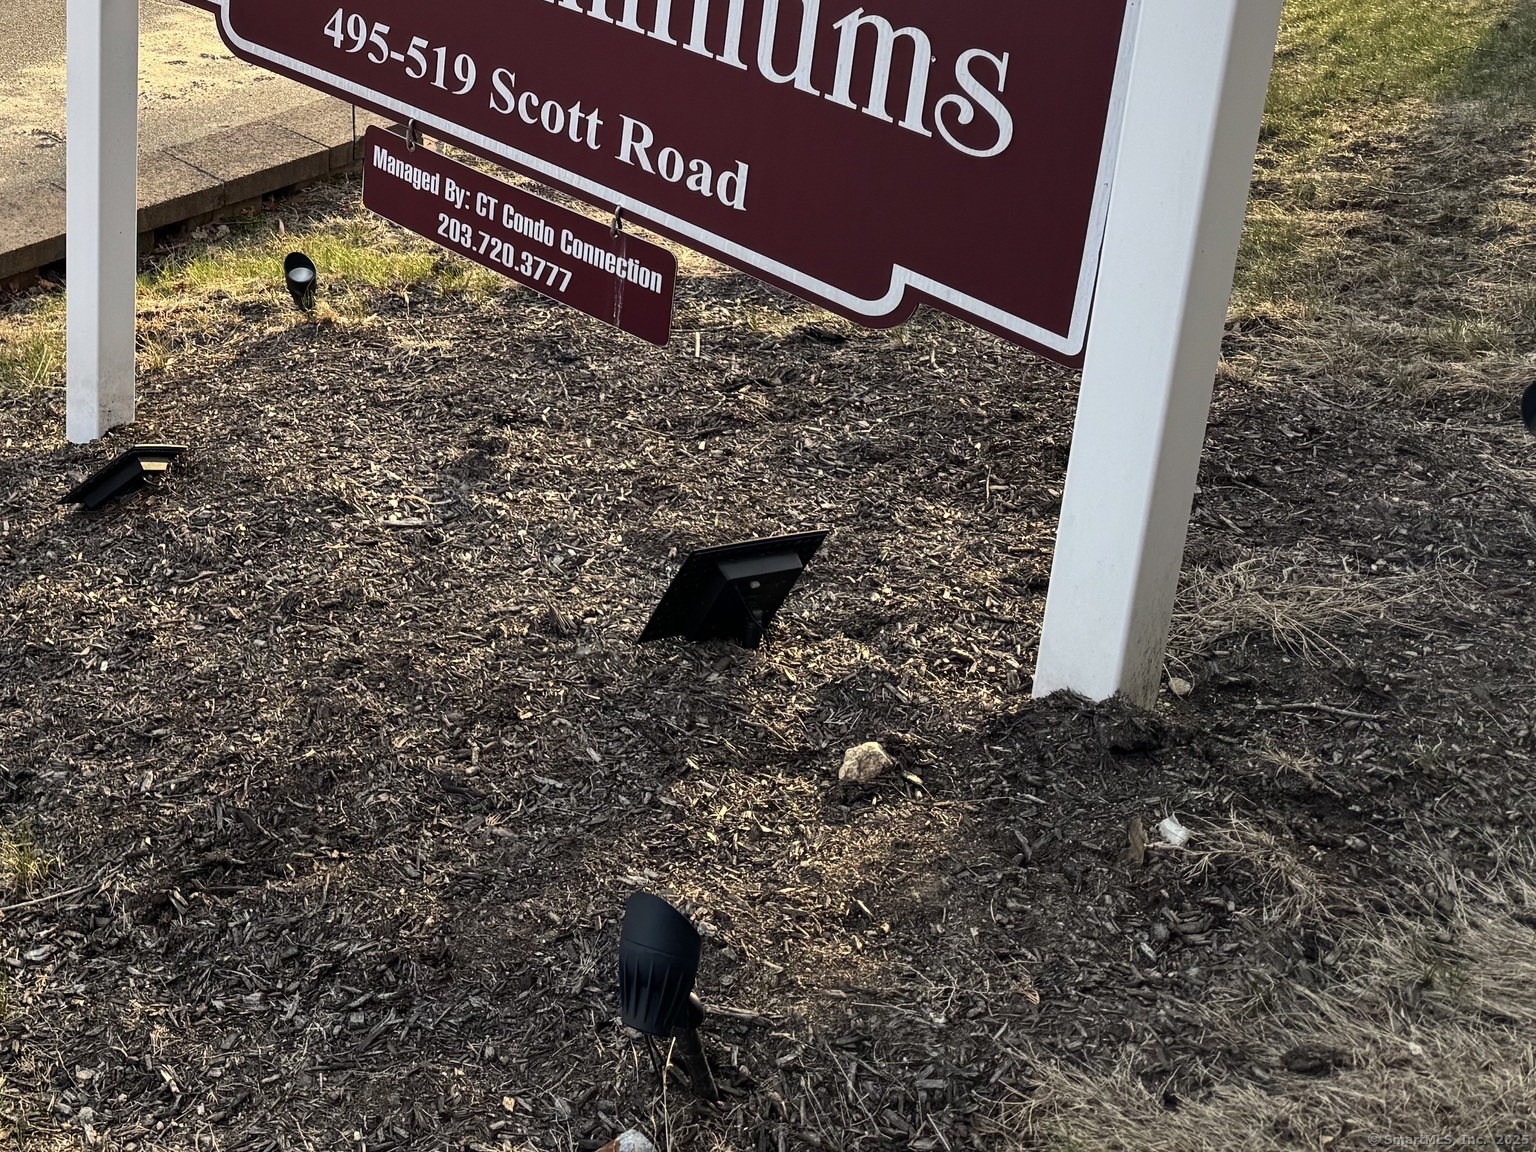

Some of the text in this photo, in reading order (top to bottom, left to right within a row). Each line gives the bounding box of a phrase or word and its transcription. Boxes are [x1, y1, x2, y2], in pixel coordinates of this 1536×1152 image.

[323, 7, 749, 212] 495-519 Scott Road
[373, 144, 663, 294] Managed By: CT Condo Connection
[438, 212, 573, 293] 203.720.3777
